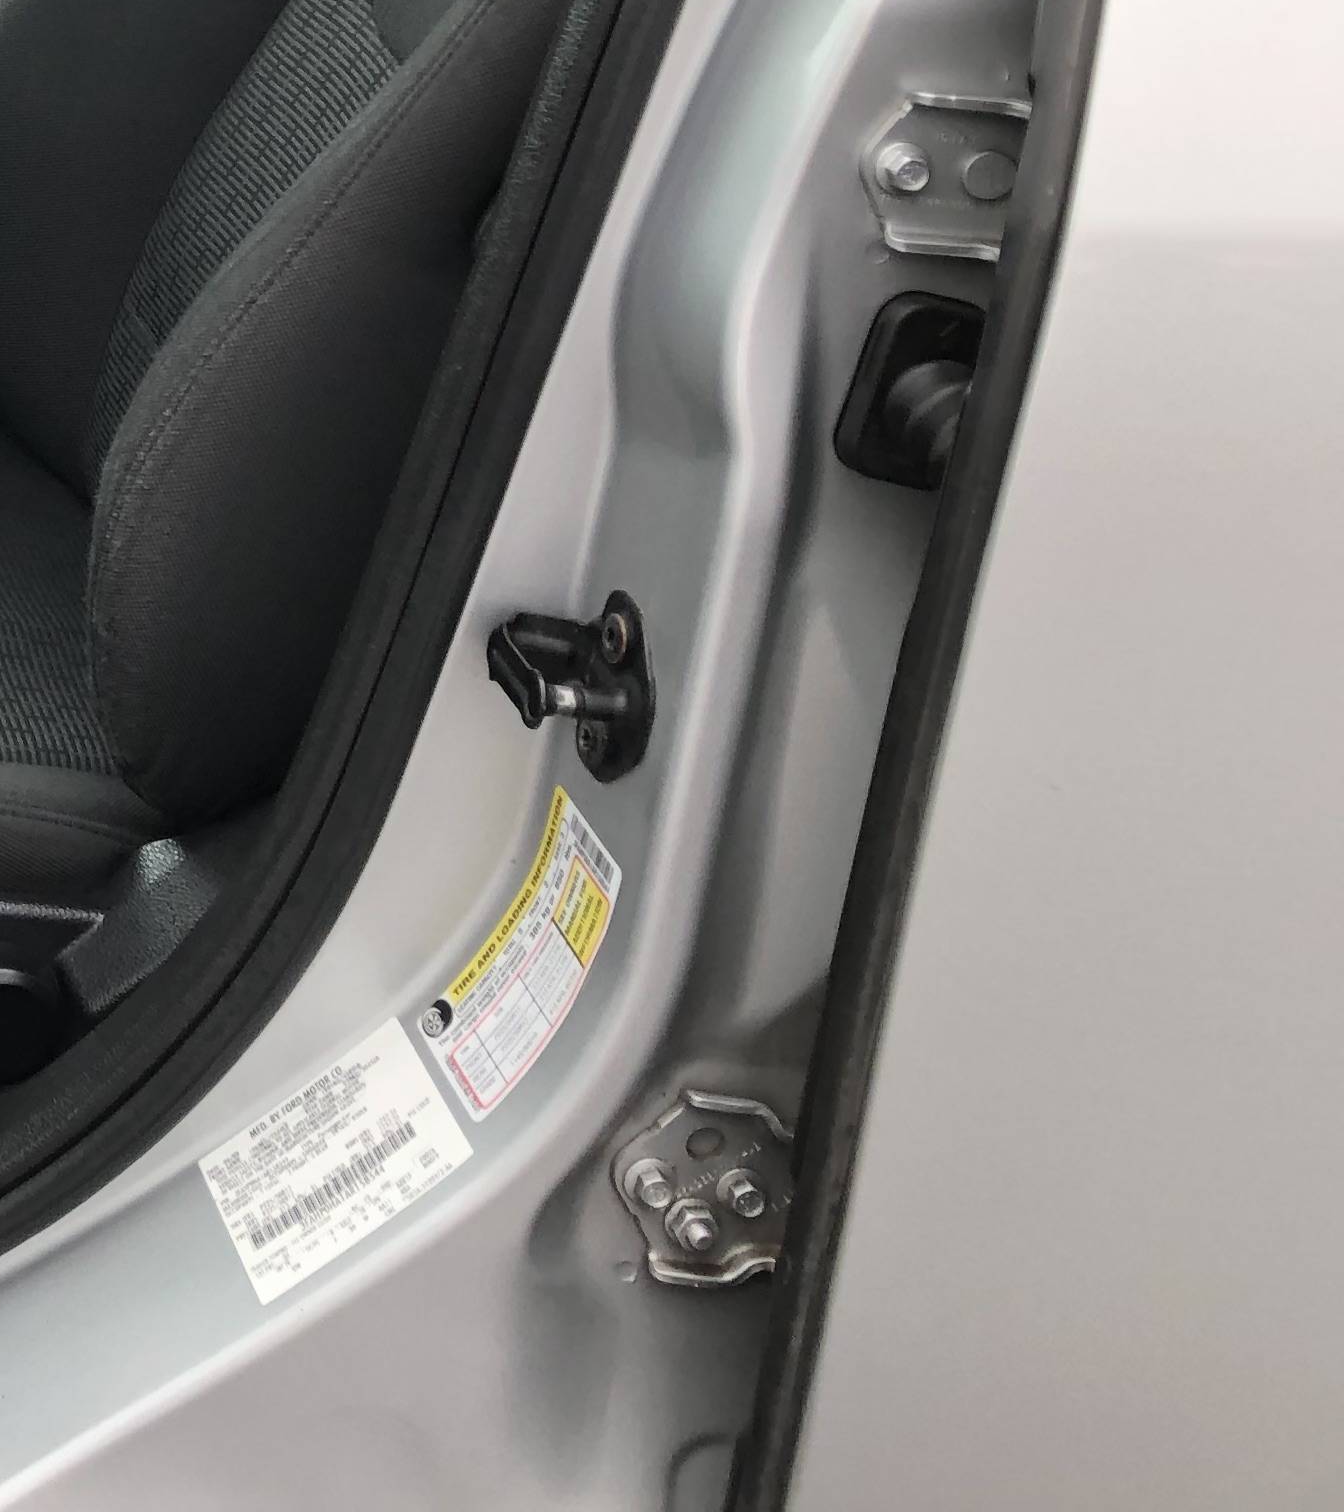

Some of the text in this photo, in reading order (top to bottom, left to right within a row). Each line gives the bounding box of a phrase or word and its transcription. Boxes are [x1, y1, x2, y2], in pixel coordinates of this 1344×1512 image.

[452, 795, 562, 995] TIRE AND LOADING INFORMATION
[269, 1110, 280, 1124] BY
[281, 1093, 304, 1115] FORD
[303, 1073, 331, 1100] MOTOR
